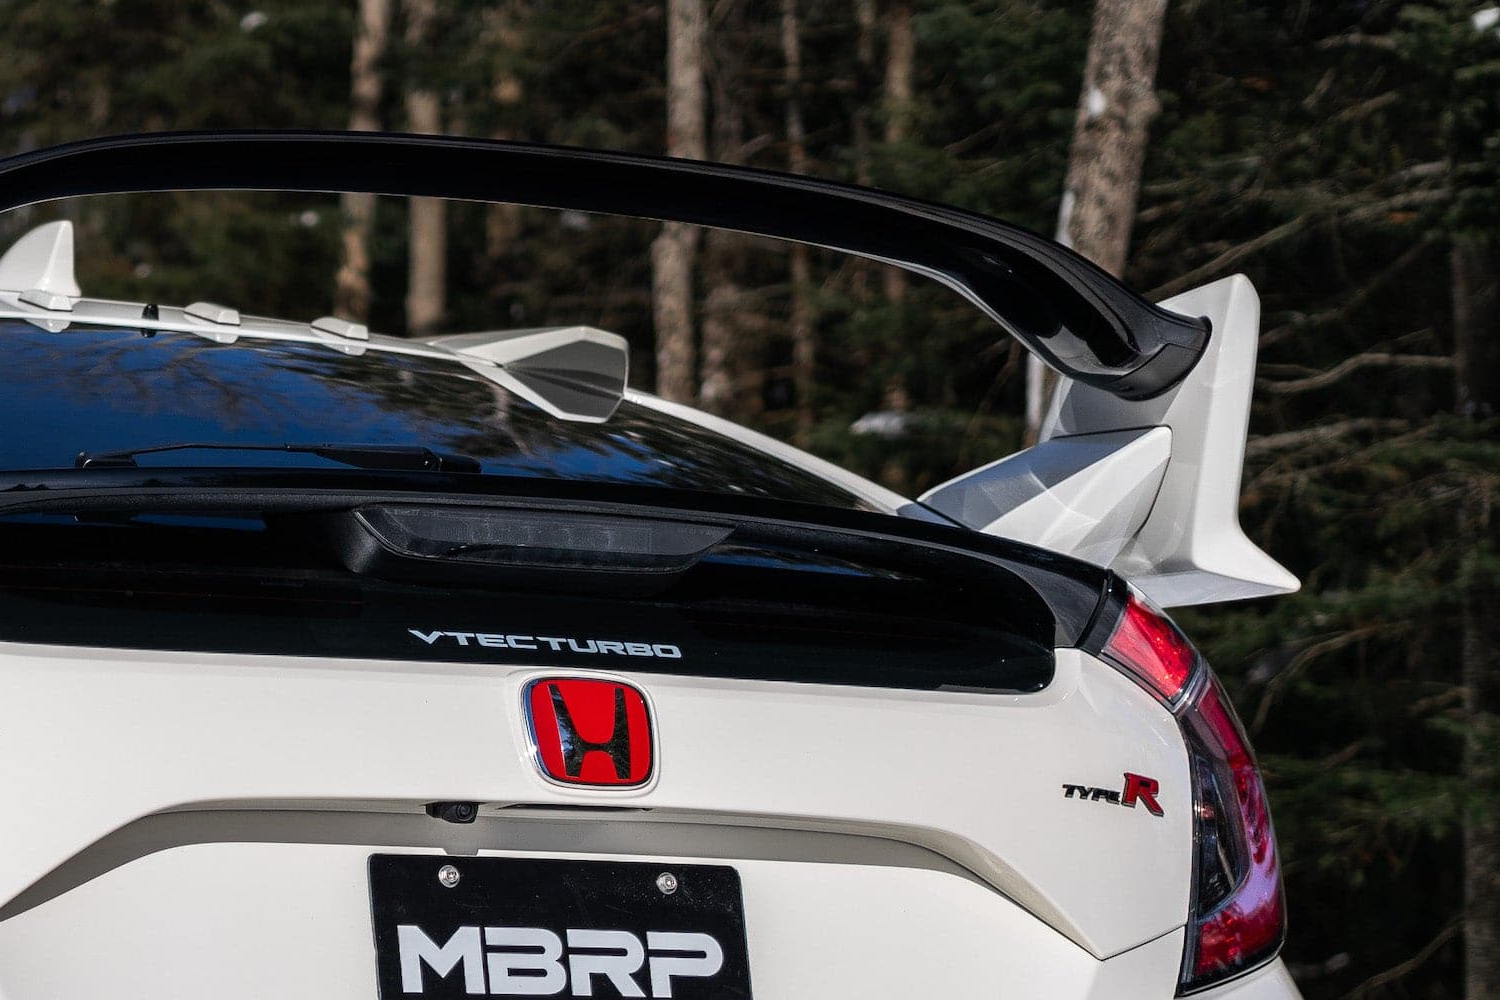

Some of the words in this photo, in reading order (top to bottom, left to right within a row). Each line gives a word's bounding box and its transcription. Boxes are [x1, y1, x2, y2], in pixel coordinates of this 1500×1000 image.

[1062, 784, 1121, 805] TYPE
[1121, 772, 1165, 817] R
[397, 924, 724, 999] MBRP
